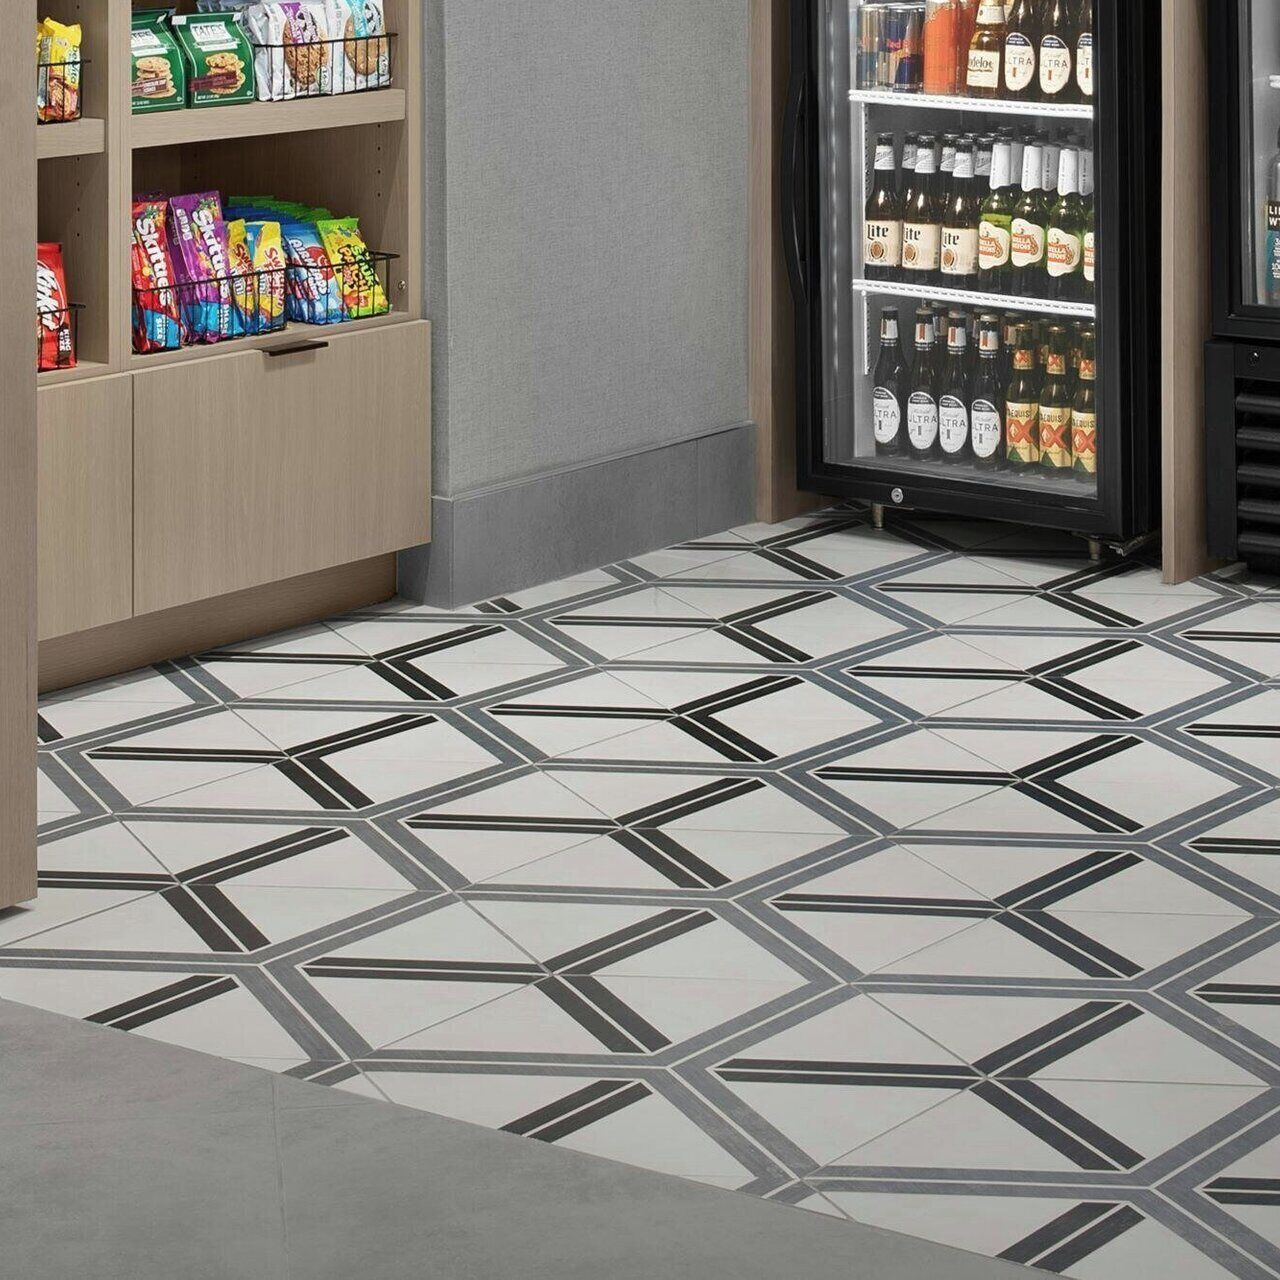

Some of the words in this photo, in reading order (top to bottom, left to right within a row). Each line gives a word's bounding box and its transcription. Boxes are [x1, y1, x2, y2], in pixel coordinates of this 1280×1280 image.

[135, 218, 171, 307] Skittles
[192, 209, 230, 300] Skittles
[867, 224, 890, 241] Lite
